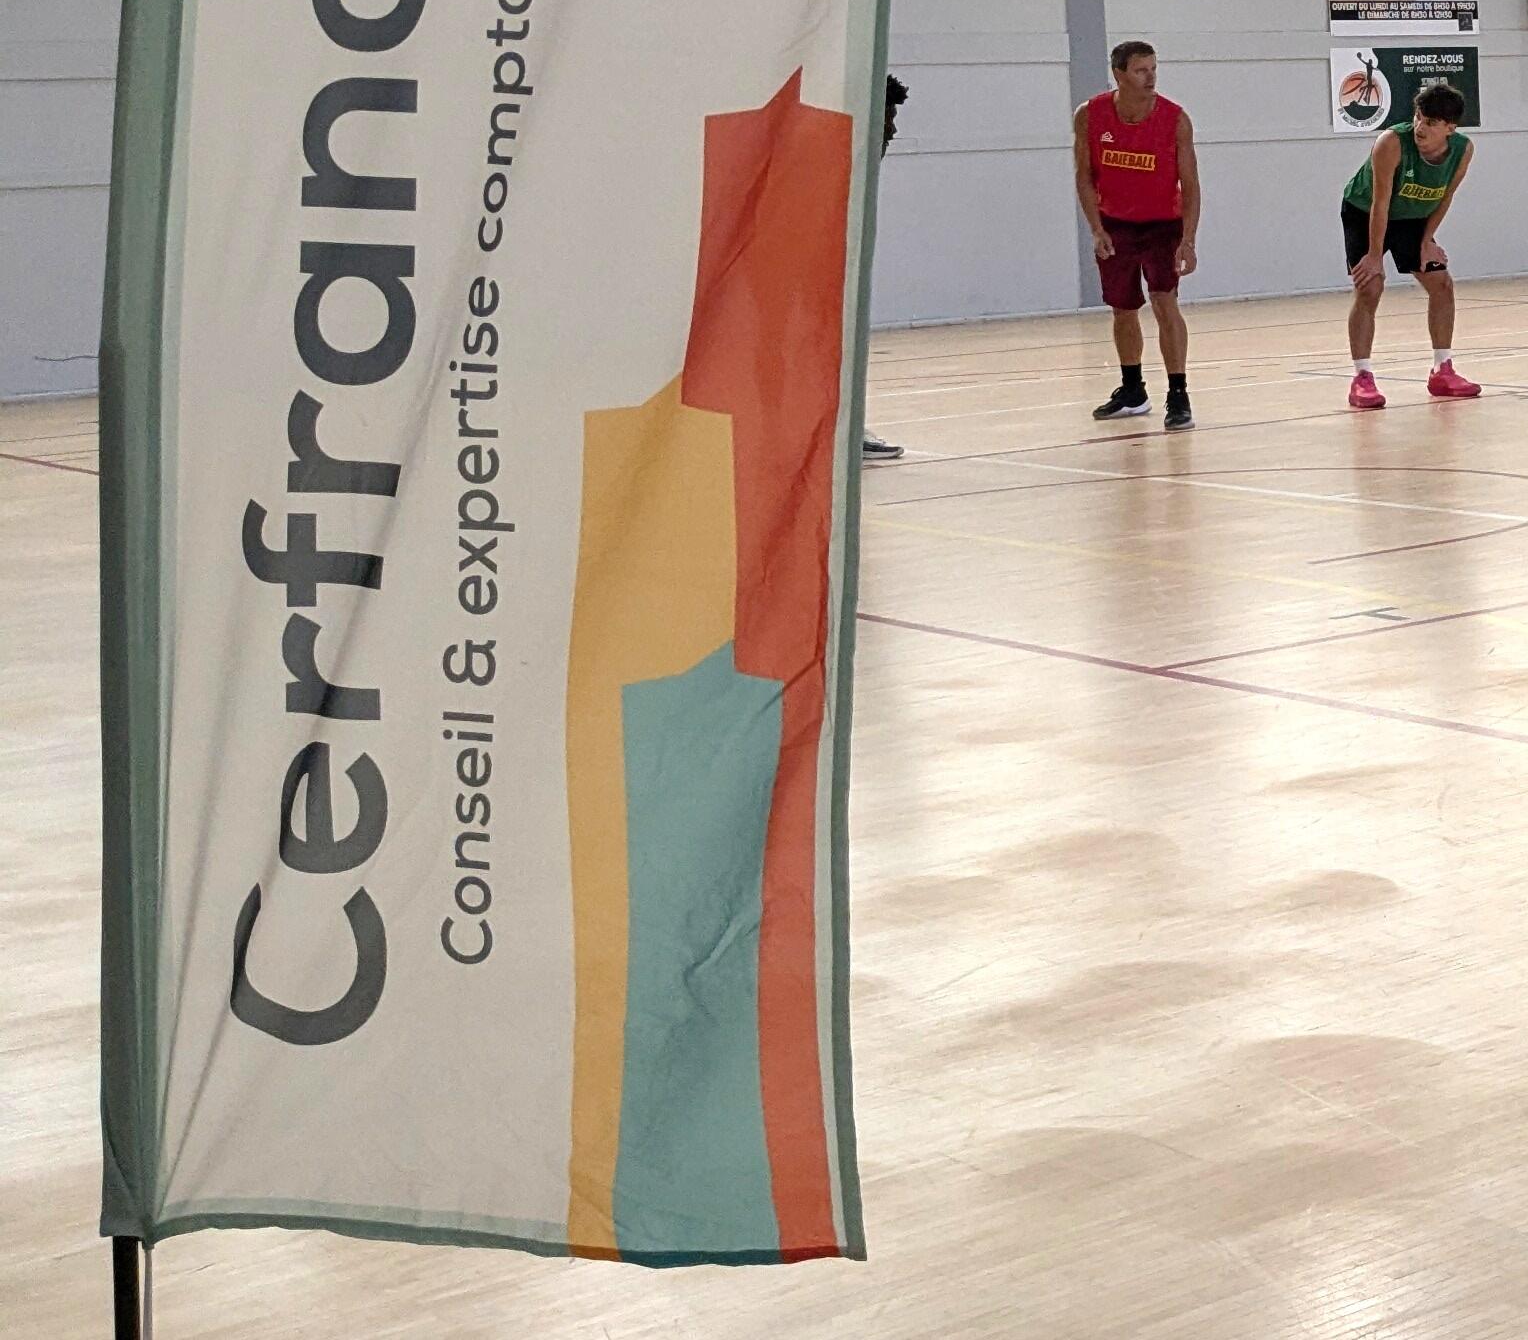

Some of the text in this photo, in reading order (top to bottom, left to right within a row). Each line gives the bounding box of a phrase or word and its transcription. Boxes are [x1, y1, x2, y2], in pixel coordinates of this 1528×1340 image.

[1402, 54, 1464, 65] RENDEZ-VOUS
[449, 275, 515, 616] expertise
[442, 638, 497, 687] &
[440, 710, 494, 966] Conseil
